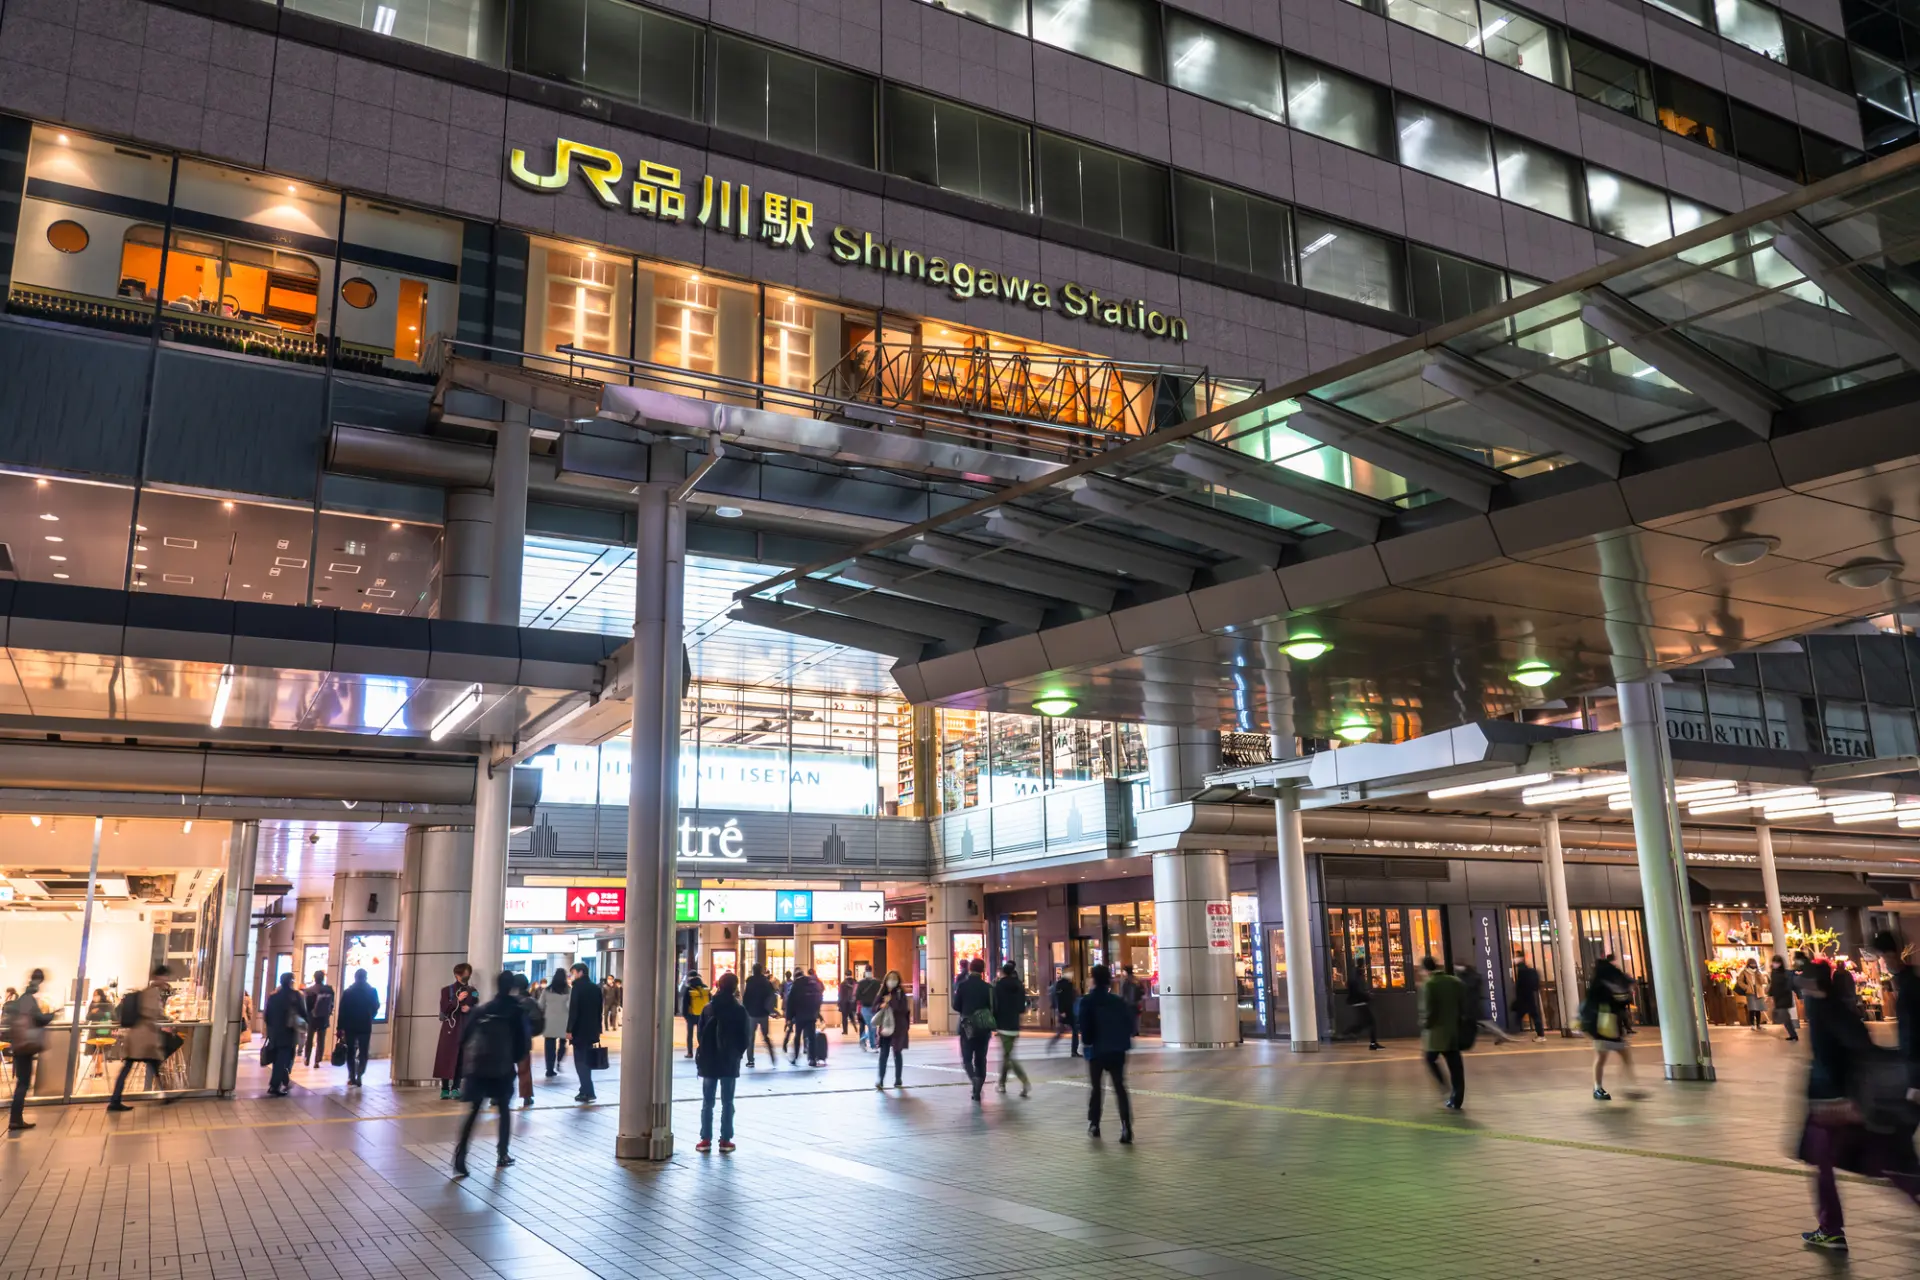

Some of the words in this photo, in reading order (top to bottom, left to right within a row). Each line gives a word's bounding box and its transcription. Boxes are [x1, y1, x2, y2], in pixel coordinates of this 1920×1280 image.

[831, 225, 1052, 308] Shinagawa
[1062, 281, 1190, 341] Station
[741, 767, 821, 786] ISETAN
[676, 816, 744, 858] tré
[1482, 917, 1491, 956] CITY
[1486, 959, 1498, 1021] BAKERY
